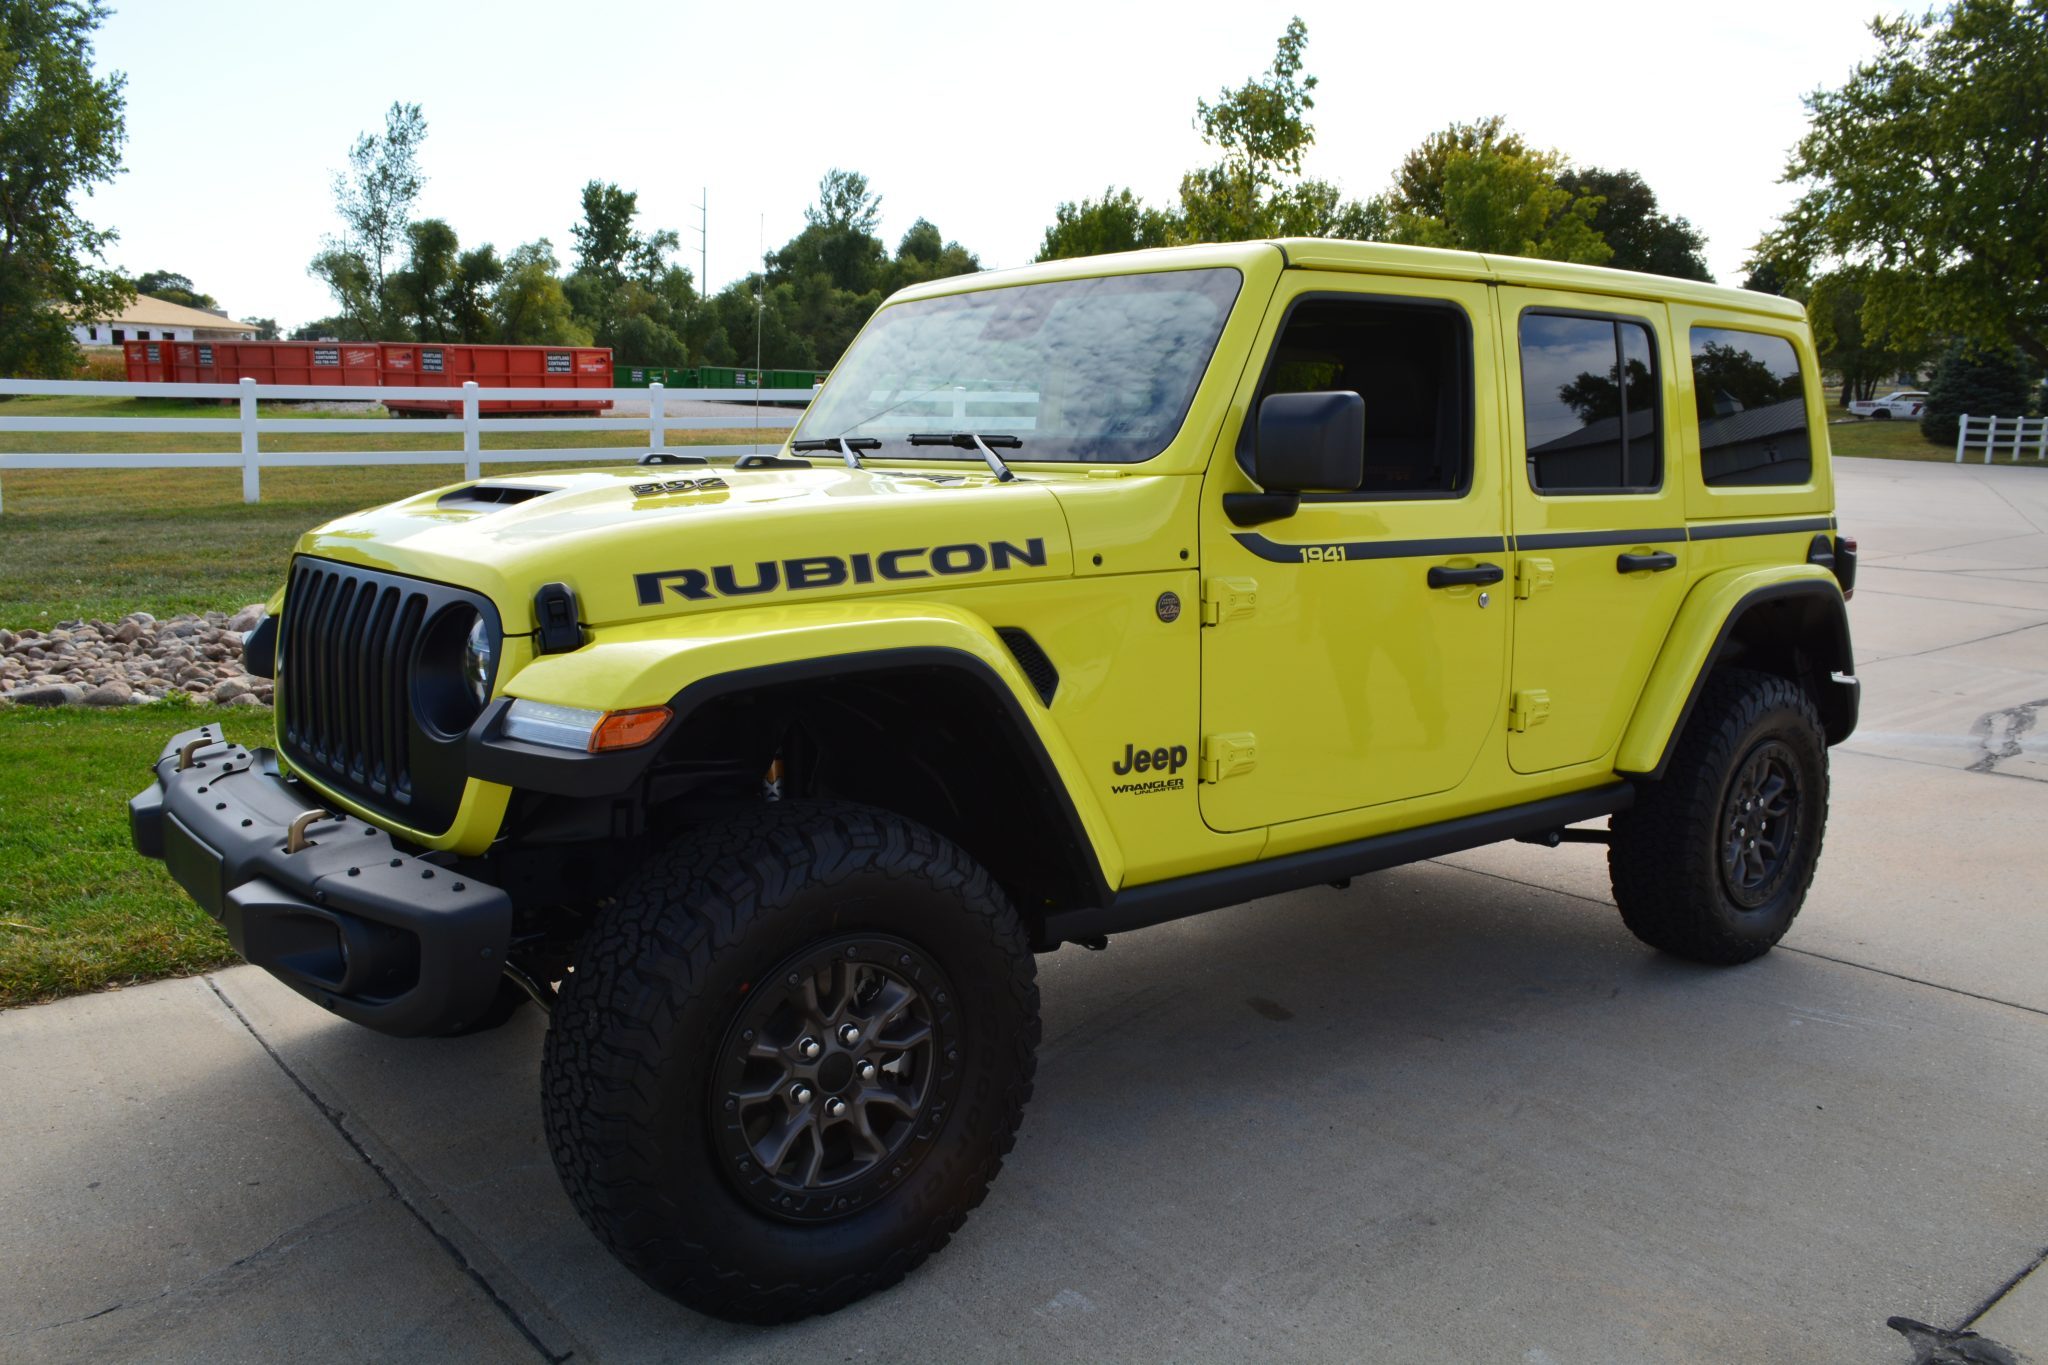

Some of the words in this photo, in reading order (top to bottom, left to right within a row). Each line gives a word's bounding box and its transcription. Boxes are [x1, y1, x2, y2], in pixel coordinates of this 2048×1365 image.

[629, 477, 730, 497] 392
[1299, 545, 1346, 564] 1941
[633, 537, 1047, 607] RUBICON
[1112, 743, 1188, 776] Jeep
[1111, 778, 1184, 794] WRANGLER
[1134, 785, 1184, 796] UNLIMITED
